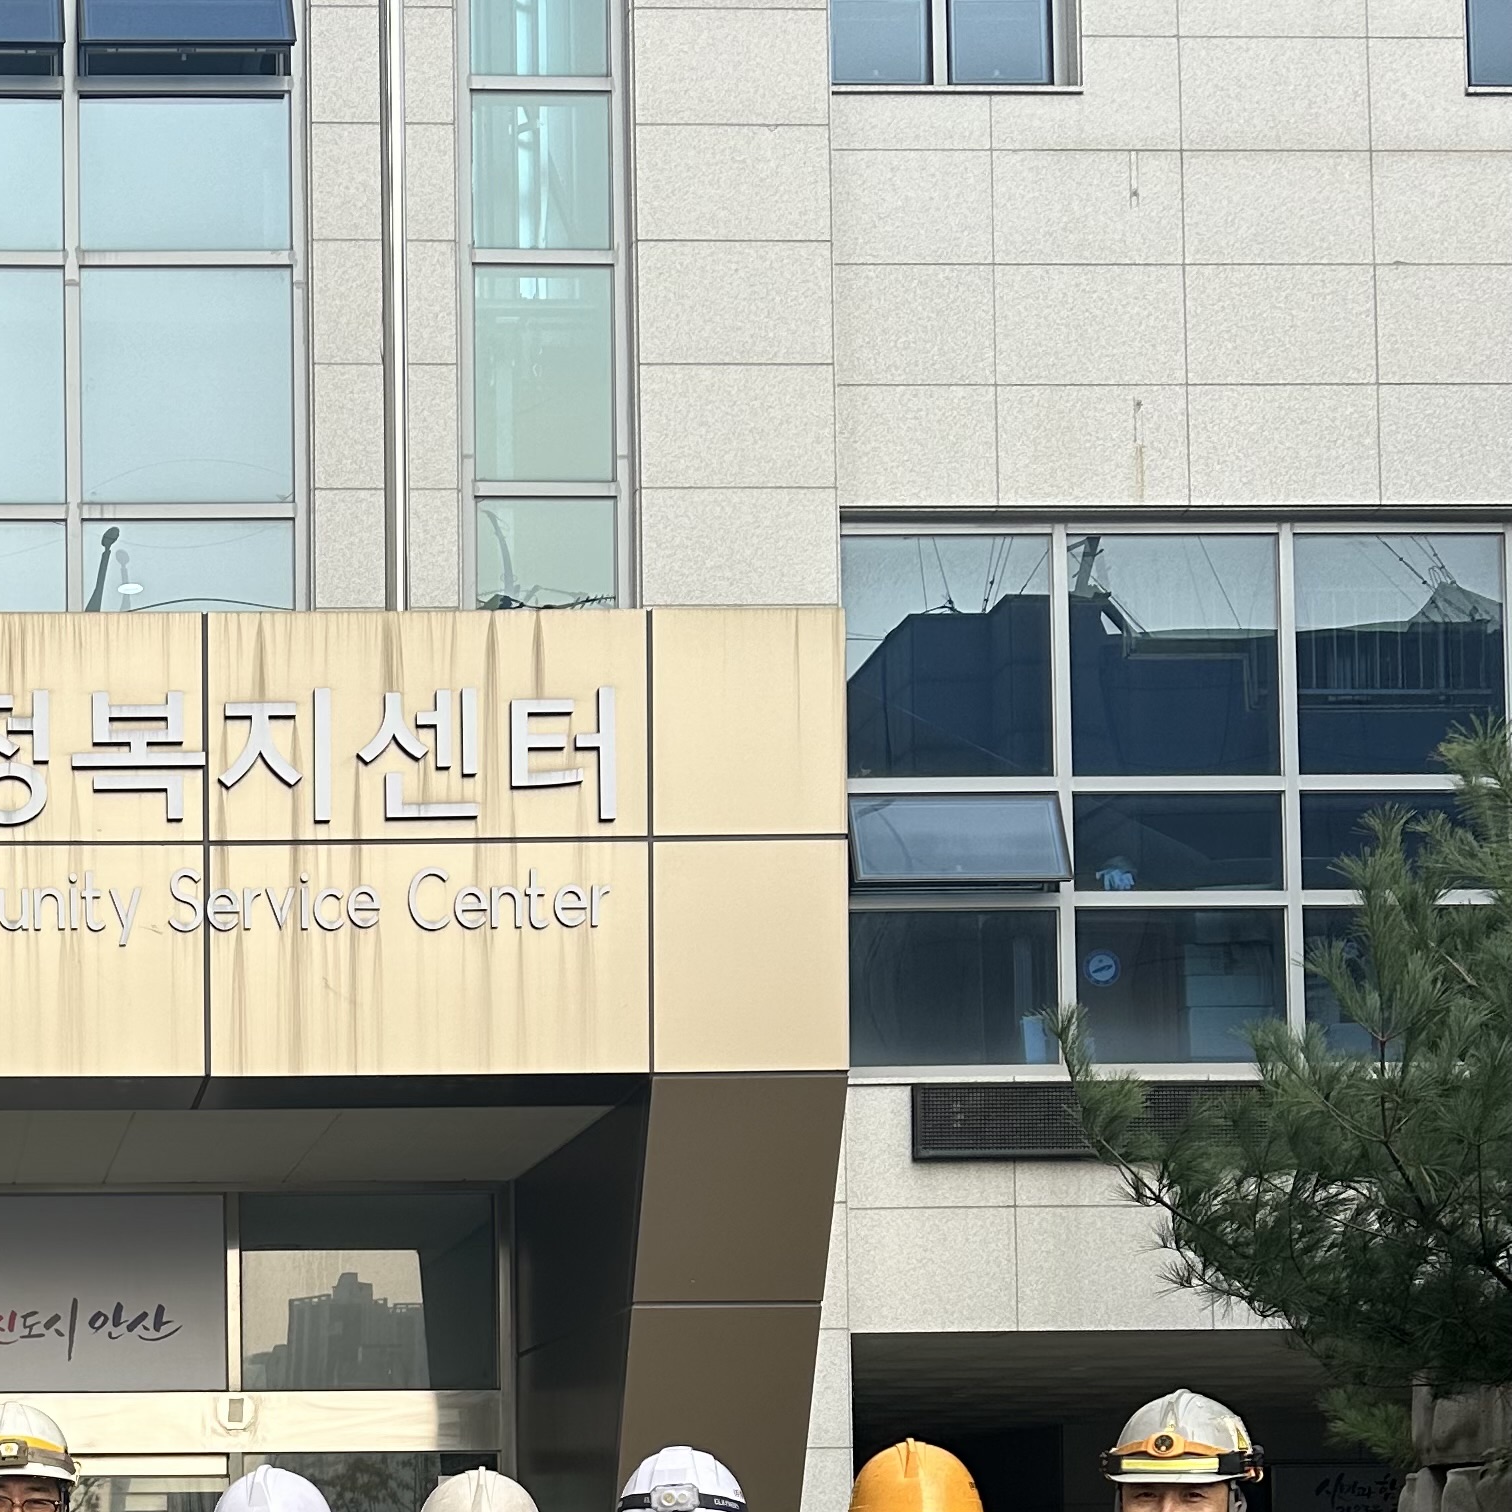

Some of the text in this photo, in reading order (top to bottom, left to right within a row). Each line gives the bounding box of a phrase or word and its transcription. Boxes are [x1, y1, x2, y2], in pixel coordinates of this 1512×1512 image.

[169, 867, 381, 932] Service
[409, 867, 610, 931] Center
[88, 1301, 183, 1341] 안산
